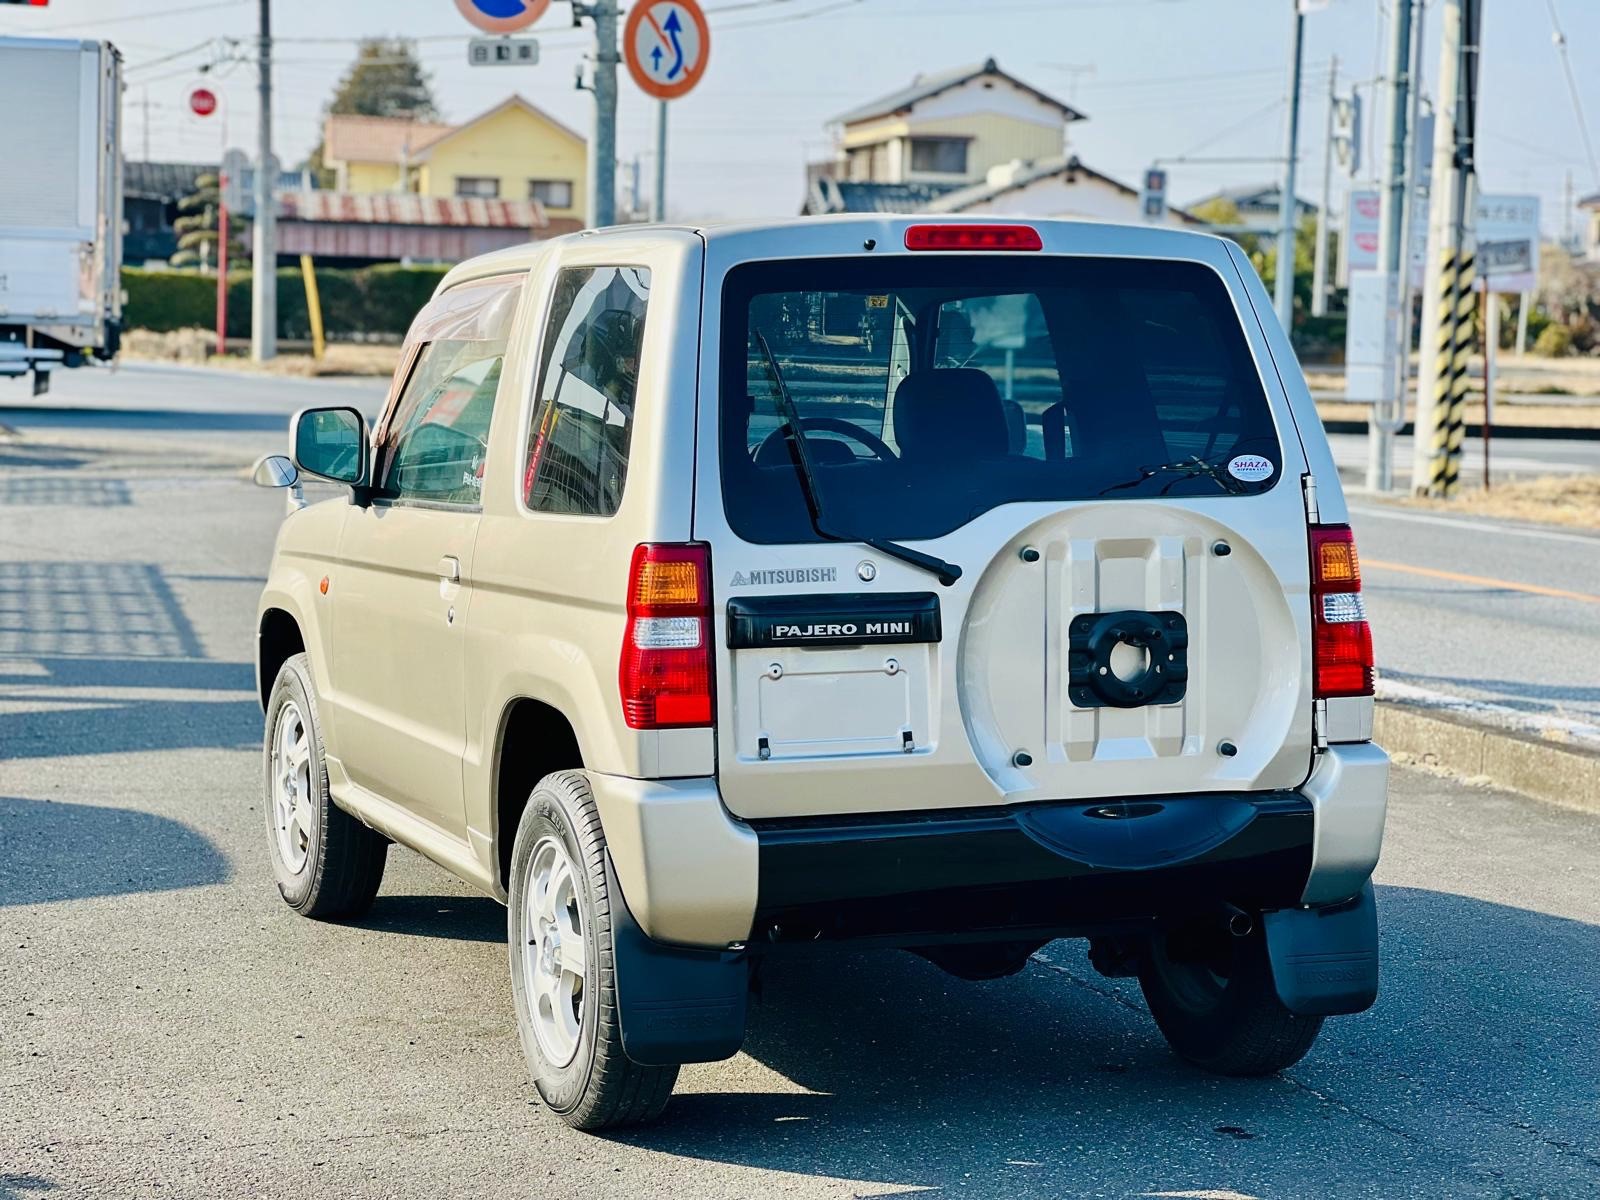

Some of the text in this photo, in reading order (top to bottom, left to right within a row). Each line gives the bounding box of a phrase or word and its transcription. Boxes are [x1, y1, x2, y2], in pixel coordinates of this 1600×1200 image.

[750, 568, 836, 584] MITSUBISHI
[775, 621, 910, 637] PAJERO MINI
